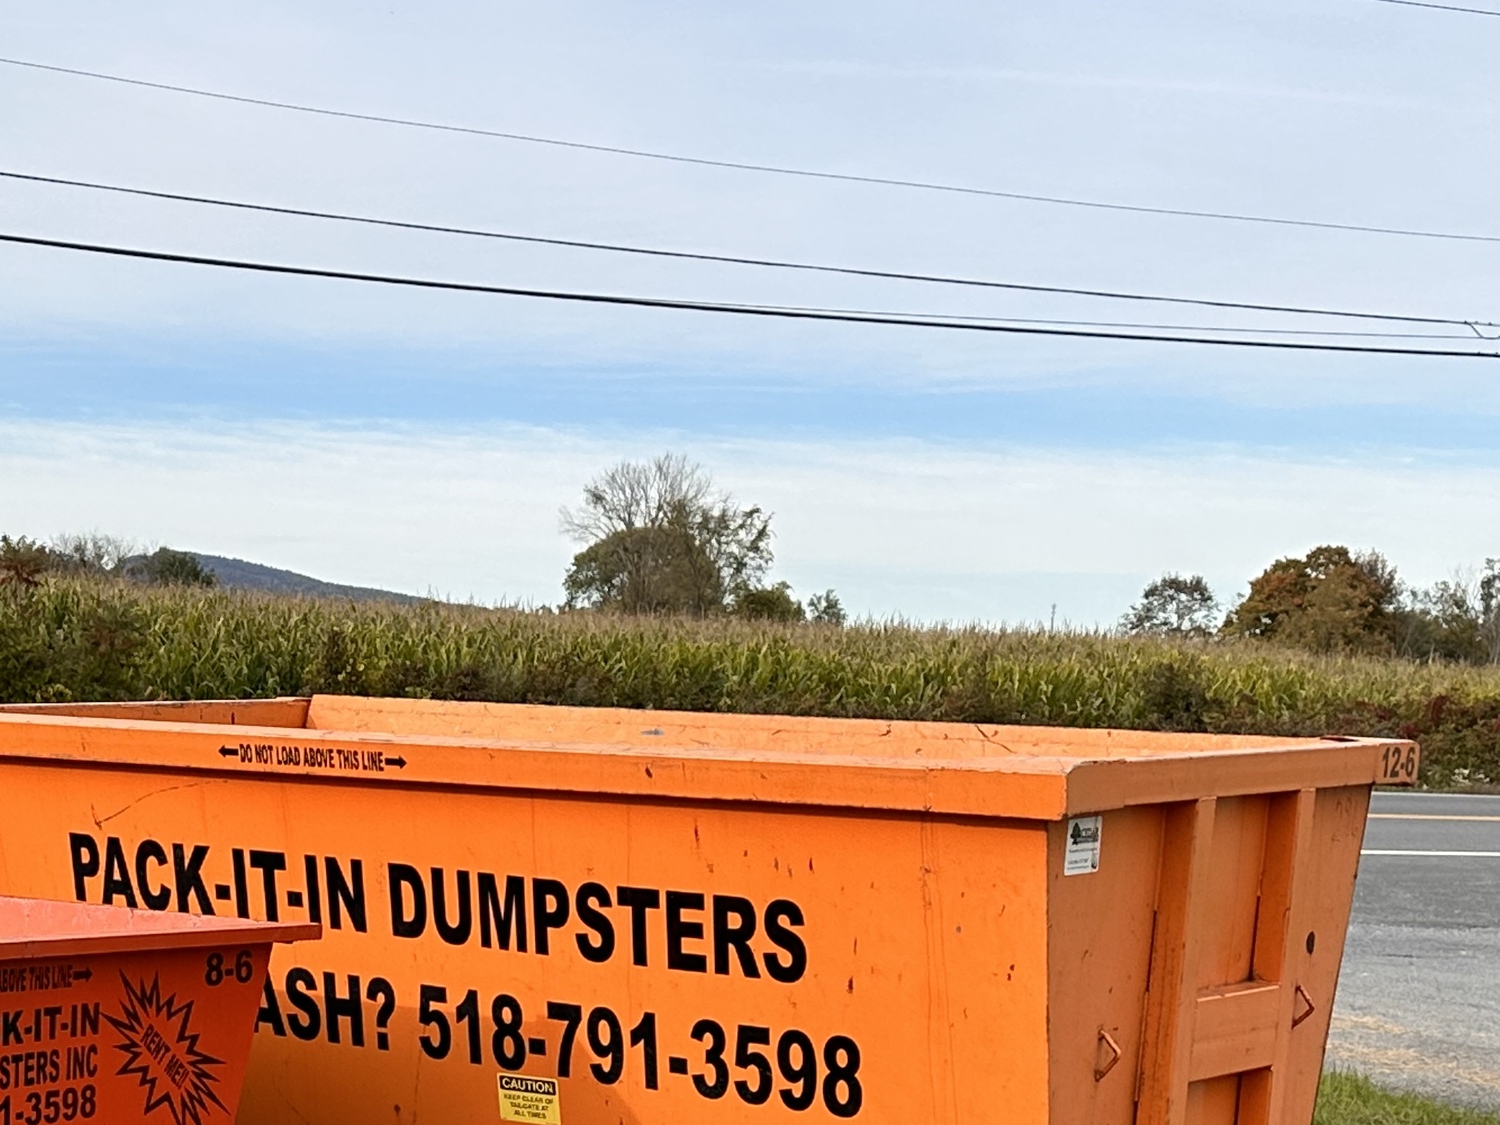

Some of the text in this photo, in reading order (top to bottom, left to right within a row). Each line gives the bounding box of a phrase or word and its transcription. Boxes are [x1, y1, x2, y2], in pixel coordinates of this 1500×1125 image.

[239, 744, 385, 771] DO NOT LOAD ABOVE THIS LINE
[1381, 746, 1416, 778] 12-6
[69, 832, 807, 983] PACK-IT-IN DUMPSTERS
[29, 966, 50, 991] THIS
[51, 964, 73, 989] LINE
[205, 950, 253, 986] 8-6
[140, 1023, 171, 1065] RENT
[419, 983, 863, 1119] 518-791-3598
[66, 1044, 98, 1081] INC
[502, 1077, 553, 1094] CAUTION
